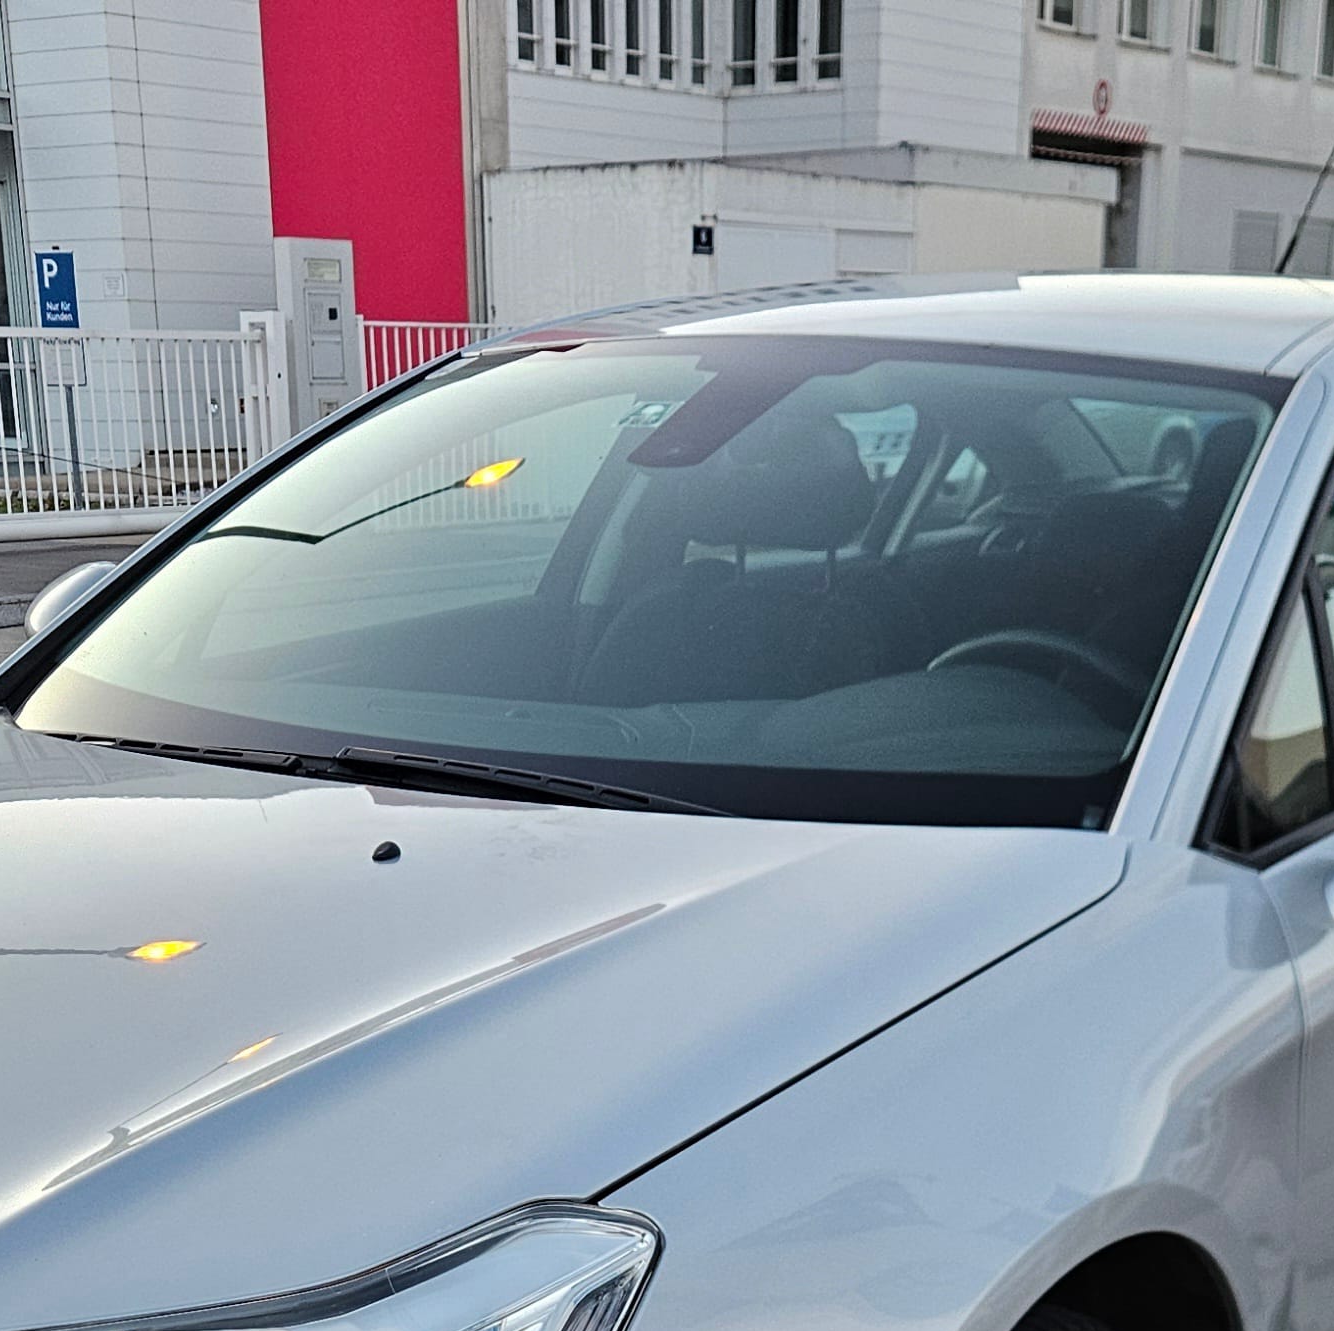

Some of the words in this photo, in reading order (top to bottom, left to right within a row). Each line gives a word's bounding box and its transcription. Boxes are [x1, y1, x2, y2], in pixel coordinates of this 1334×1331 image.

[46, 300, 60, 311] Nur
[61, 300, 71, 311] für
[46, 311, 73, 321] Kunden
